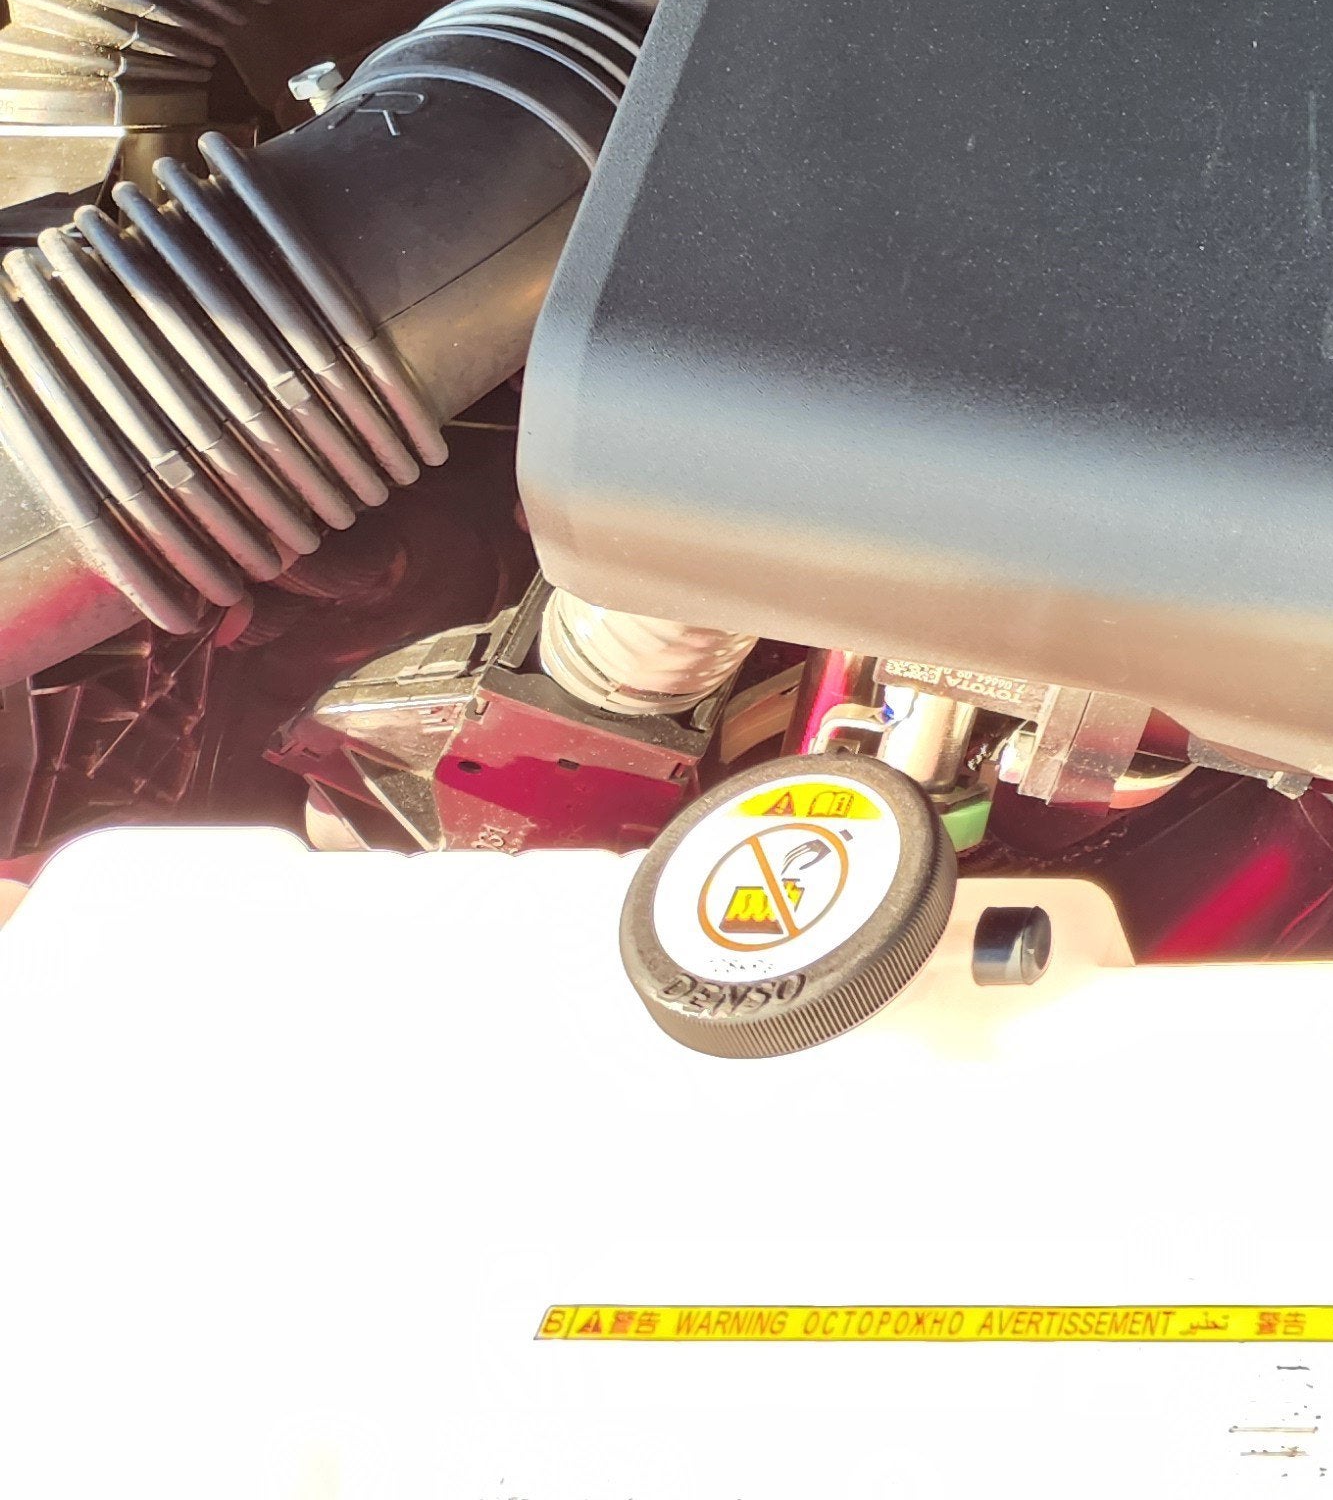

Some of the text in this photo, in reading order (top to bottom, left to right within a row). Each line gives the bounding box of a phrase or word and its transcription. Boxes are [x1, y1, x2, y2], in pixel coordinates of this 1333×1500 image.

[945, 675, 1023, 703] TOYOTA
[655, 972, 807, 1016] DENSO
[675, 1310, 789, 1336] WARNING
[977, 1310, 1176, 1336] AVERTISSEMENT
